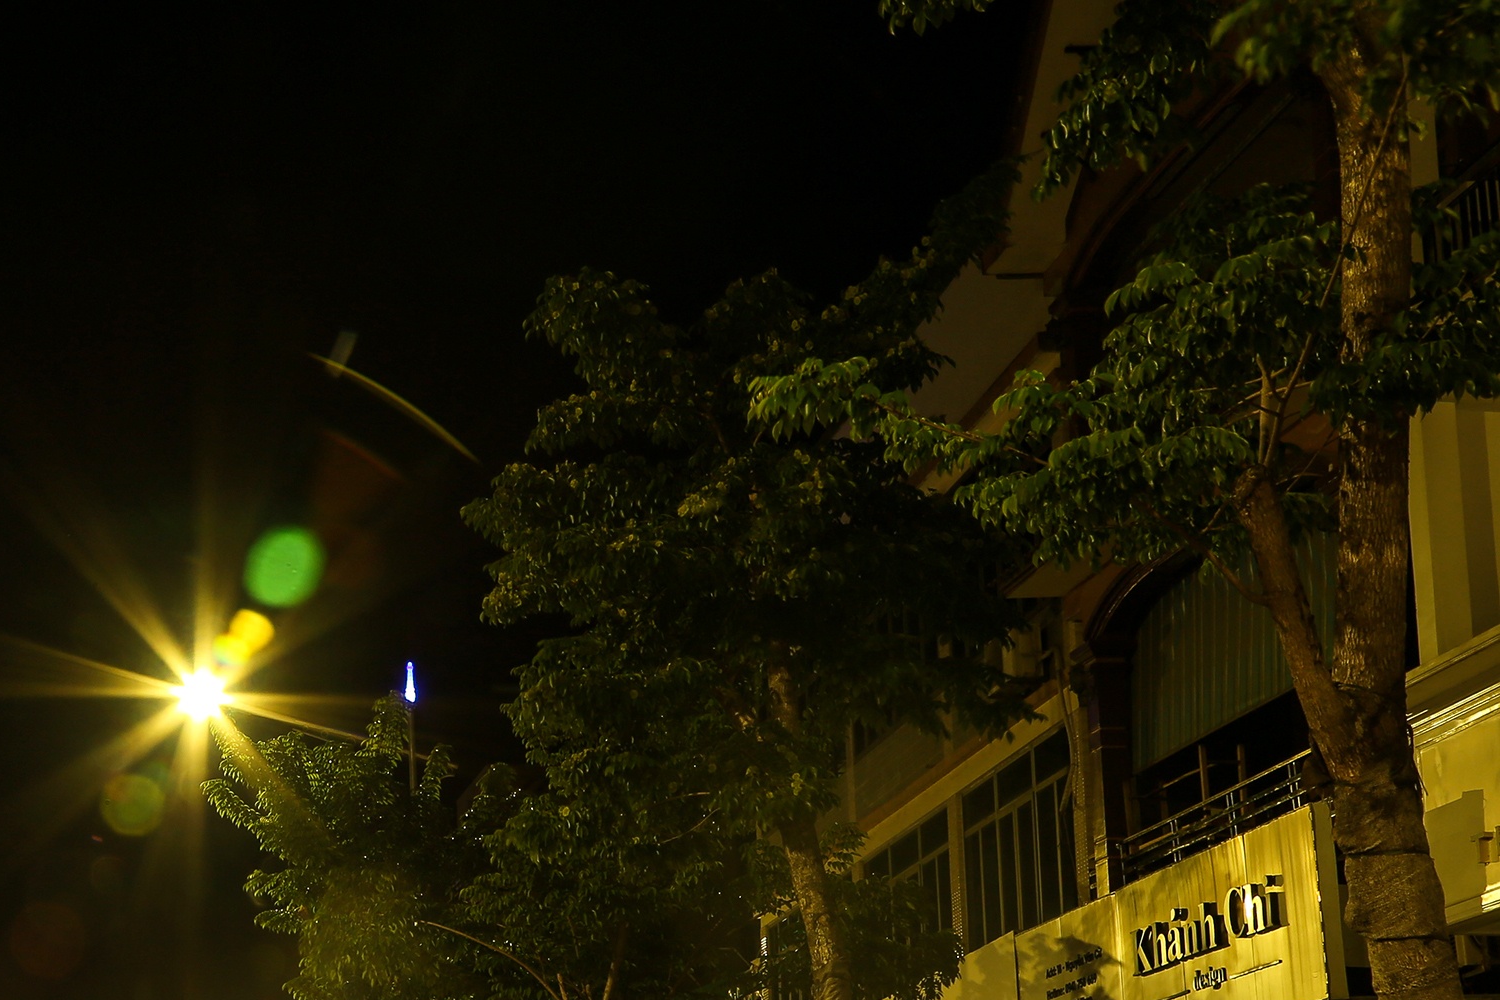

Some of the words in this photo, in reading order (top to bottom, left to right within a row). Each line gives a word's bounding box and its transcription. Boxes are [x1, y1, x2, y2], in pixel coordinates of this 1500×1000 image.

[1133, 901, 1229, 976] Khánh
[1224, 874, 1289, 938] Chi
[1193, 966, 1227, 992] design
